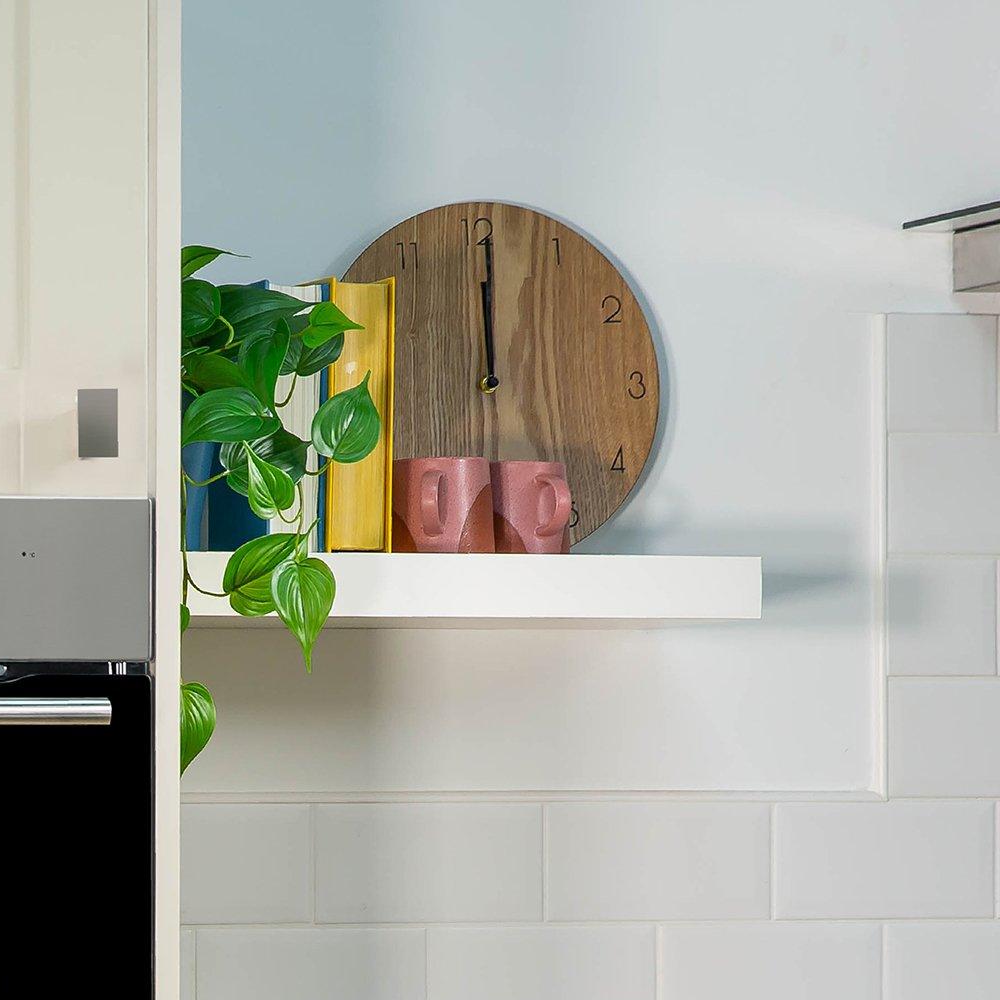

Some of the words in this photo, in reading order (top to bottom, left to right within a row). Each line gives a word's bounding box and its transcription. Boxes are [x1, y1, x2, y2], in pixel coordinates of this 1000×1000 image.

[460, 217, 494, 246] 12
[396, 242, 419, 270] 11
[551, 237, 560, 266] 1
[601, 294, 622, 324] 2
[627, 370, 646, 400] 3
[610, 444, 626, 474] 4
